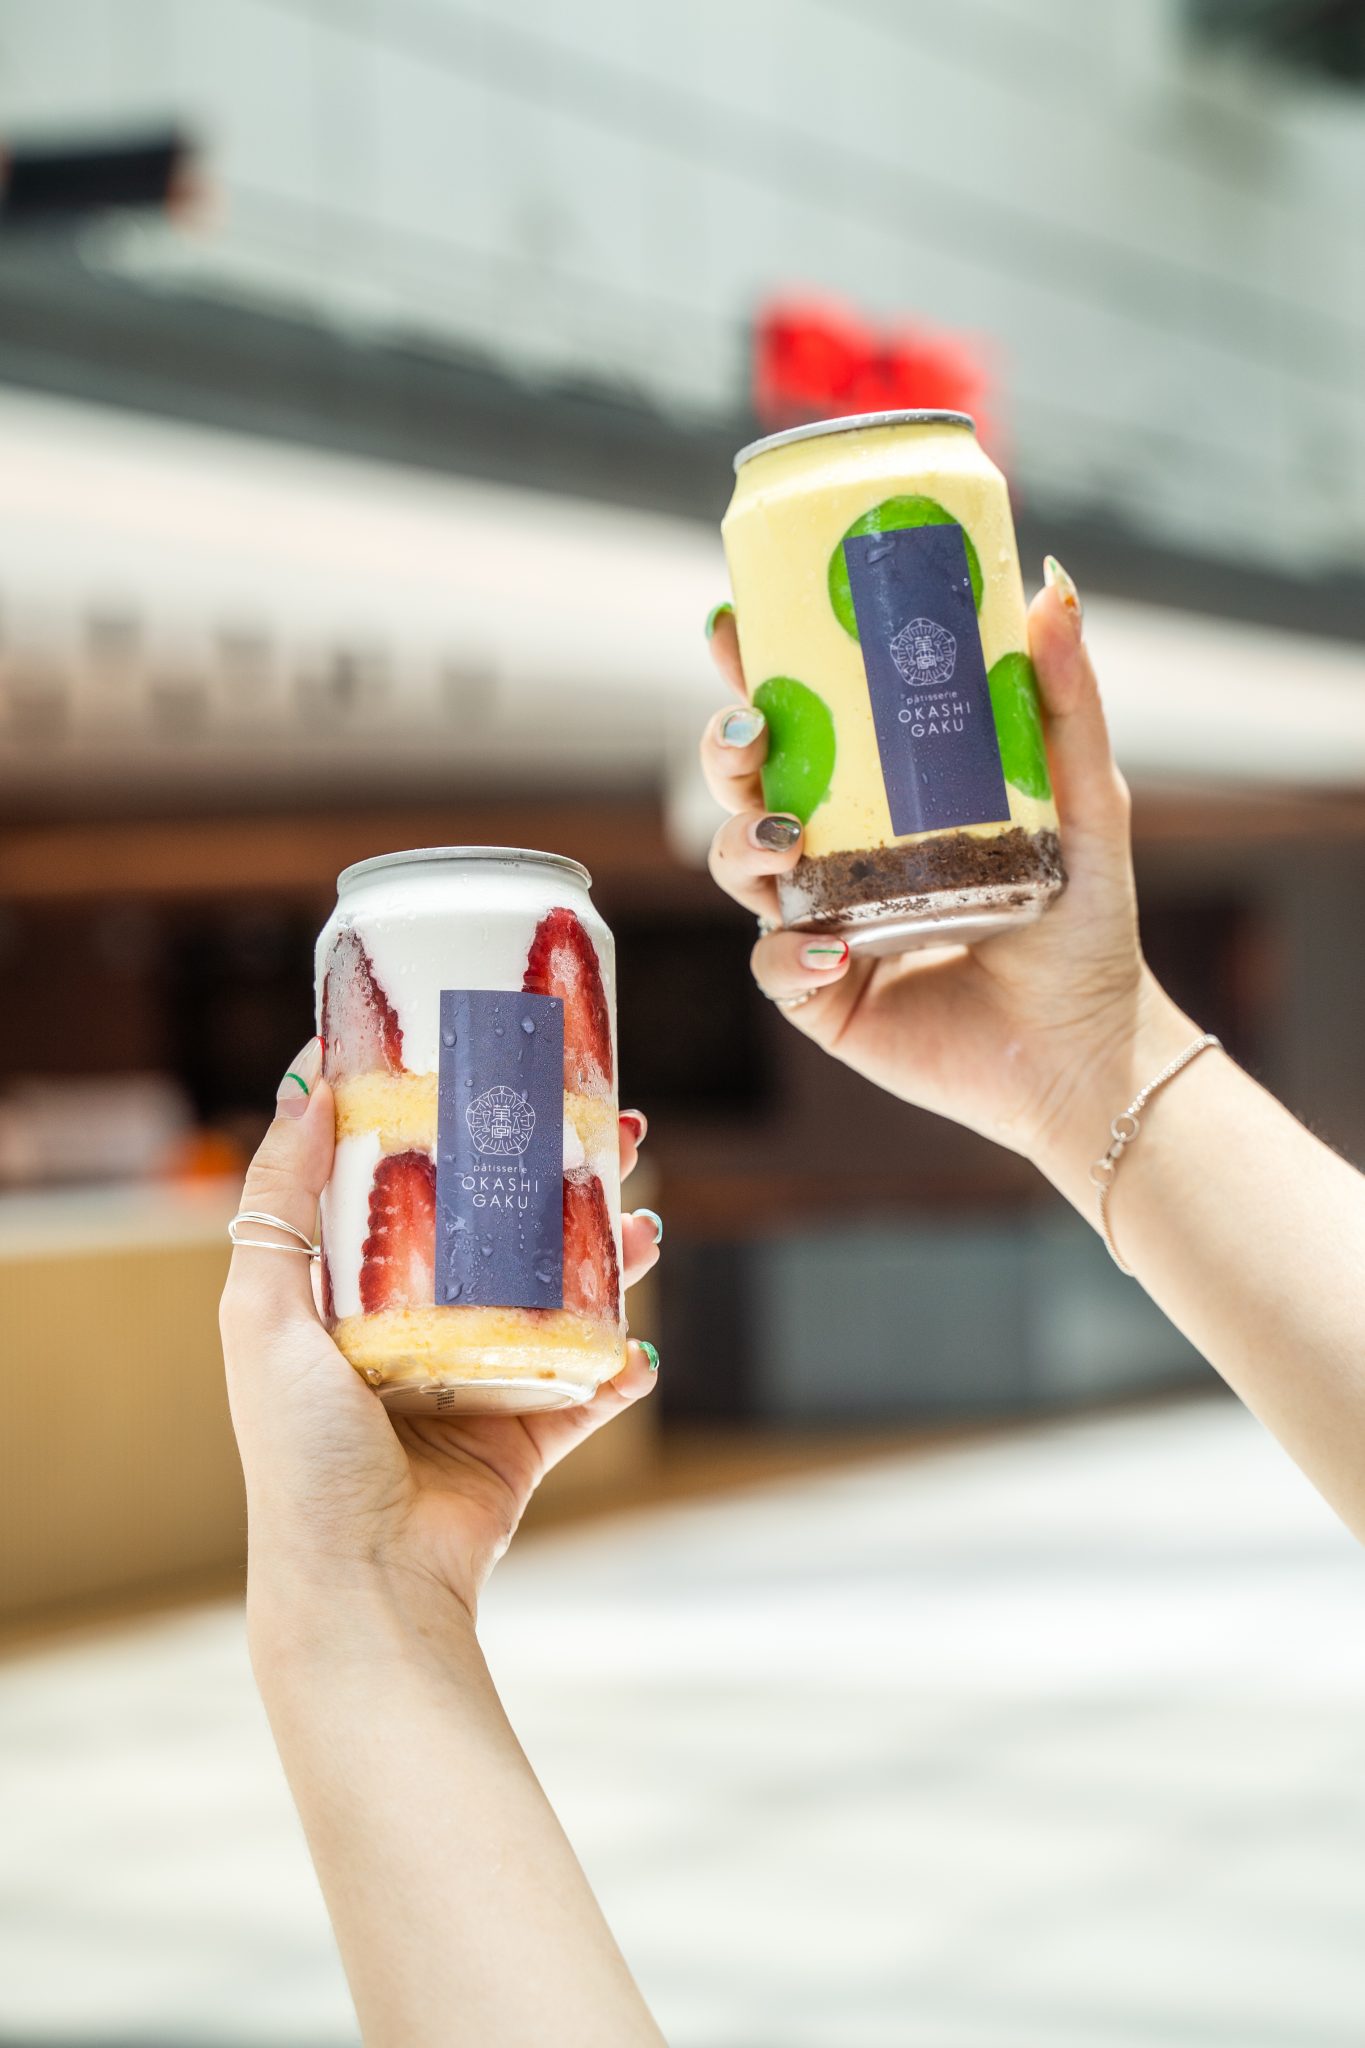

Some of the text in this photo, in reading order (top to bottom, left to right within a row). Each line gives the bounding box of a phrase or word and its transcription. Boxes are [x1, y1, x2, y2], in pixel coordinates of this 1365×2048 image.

[898, 701, 971, 723] OKASHI
[911, 718, 964, 737] GAKU
[461, 1176, 538, 1193] OKASHI
[472, 1193, 528, 1210] GAKU
